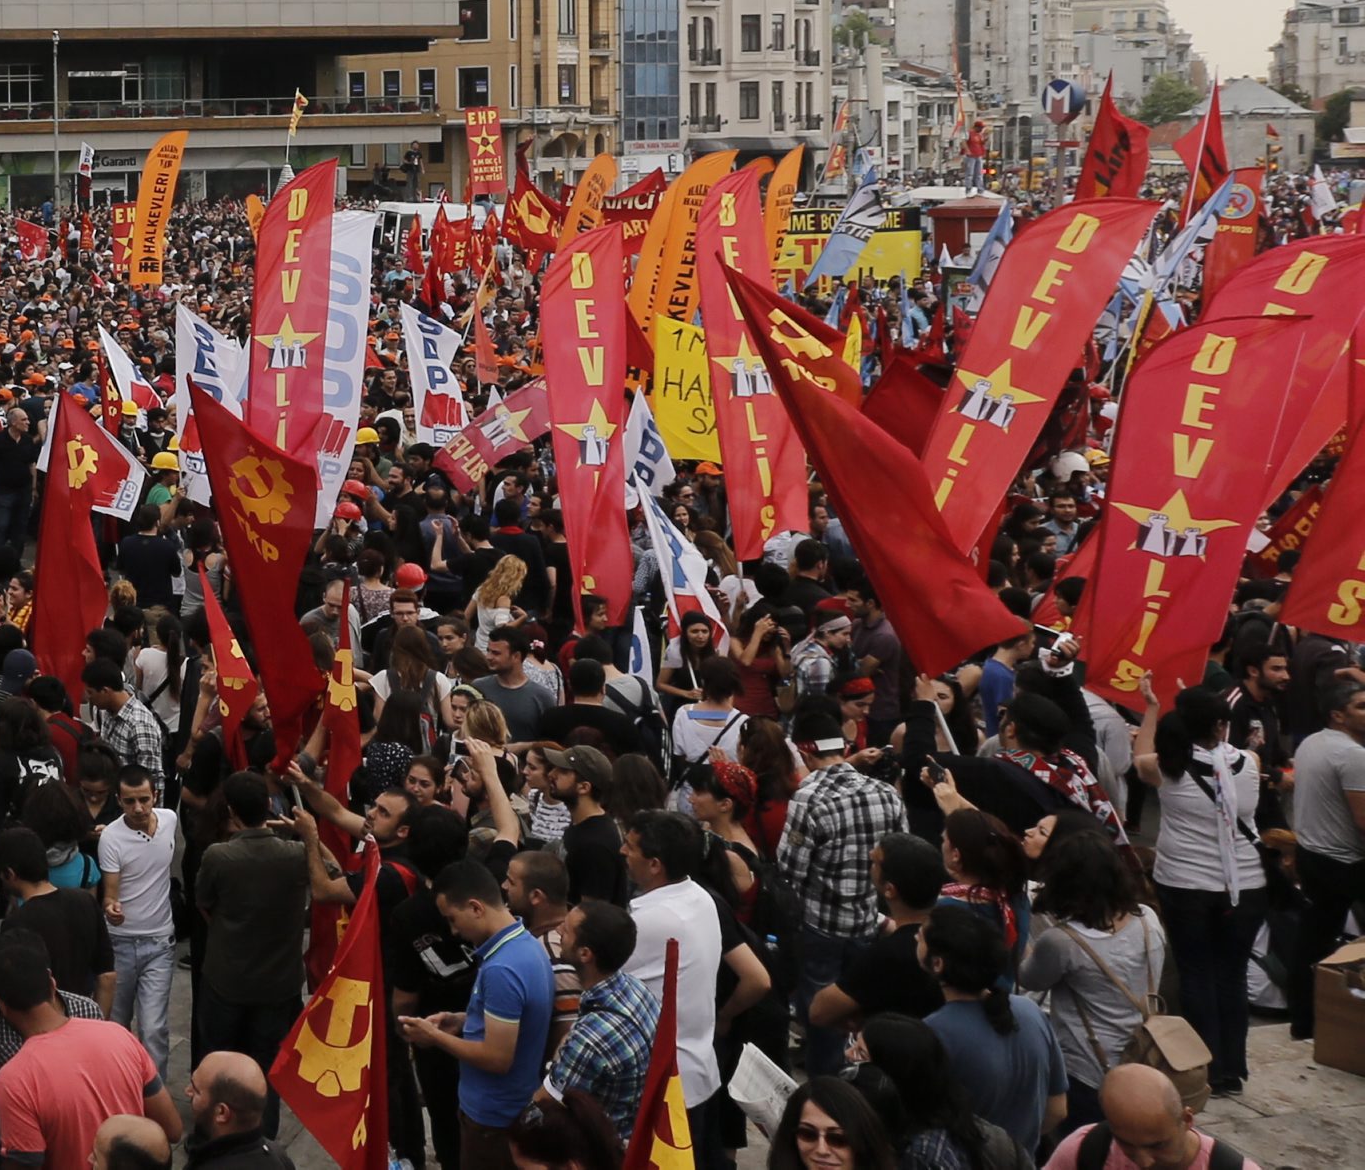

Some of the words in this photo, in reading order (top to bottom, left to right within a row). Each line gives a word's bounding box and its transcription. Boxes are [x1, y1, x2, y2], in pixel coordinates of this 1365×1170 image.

[467, 110, 497, 126] EHP
[101, 156, 137, 167] Garanti
[115, 208, 137, 224] EH
[668, 232, 696, 322] KEVLERİ
[417, 312, 449, 391] SDP
[570, 251, 605, 386] DEV
[1172, 332, 1238, 479] DEV
